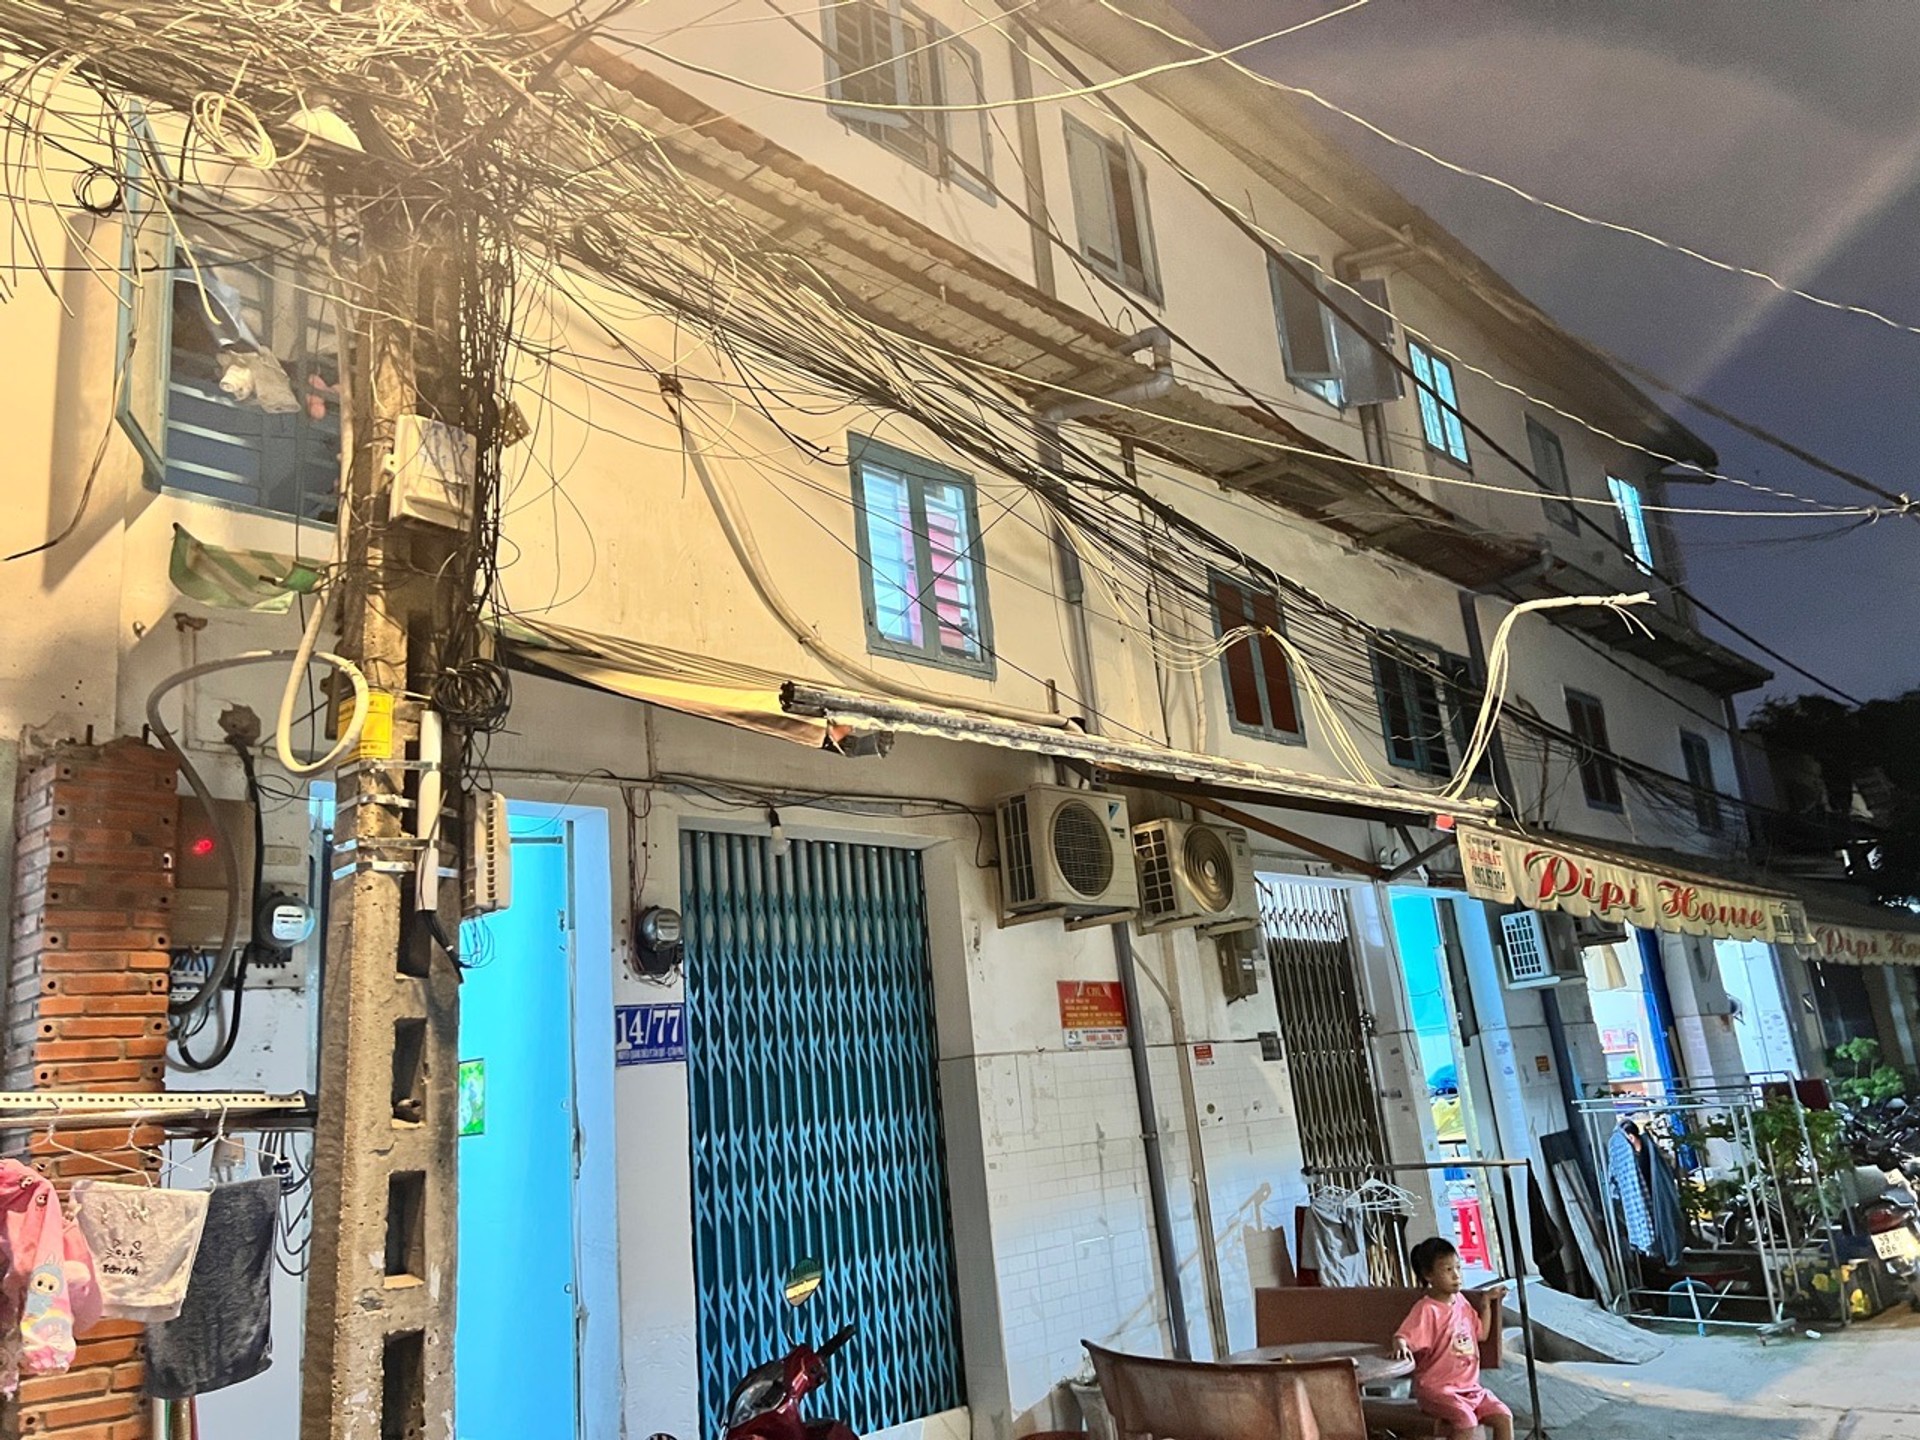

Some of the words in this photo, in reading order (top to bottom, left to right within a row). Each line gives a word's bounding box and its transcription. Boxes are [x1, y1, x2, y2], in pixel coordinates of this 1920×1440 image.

[1523, 850, 1645, 915] Pipi
[1656, 880, 1767, 930] Home
[616, 1008, 681, 1050] 14/77
